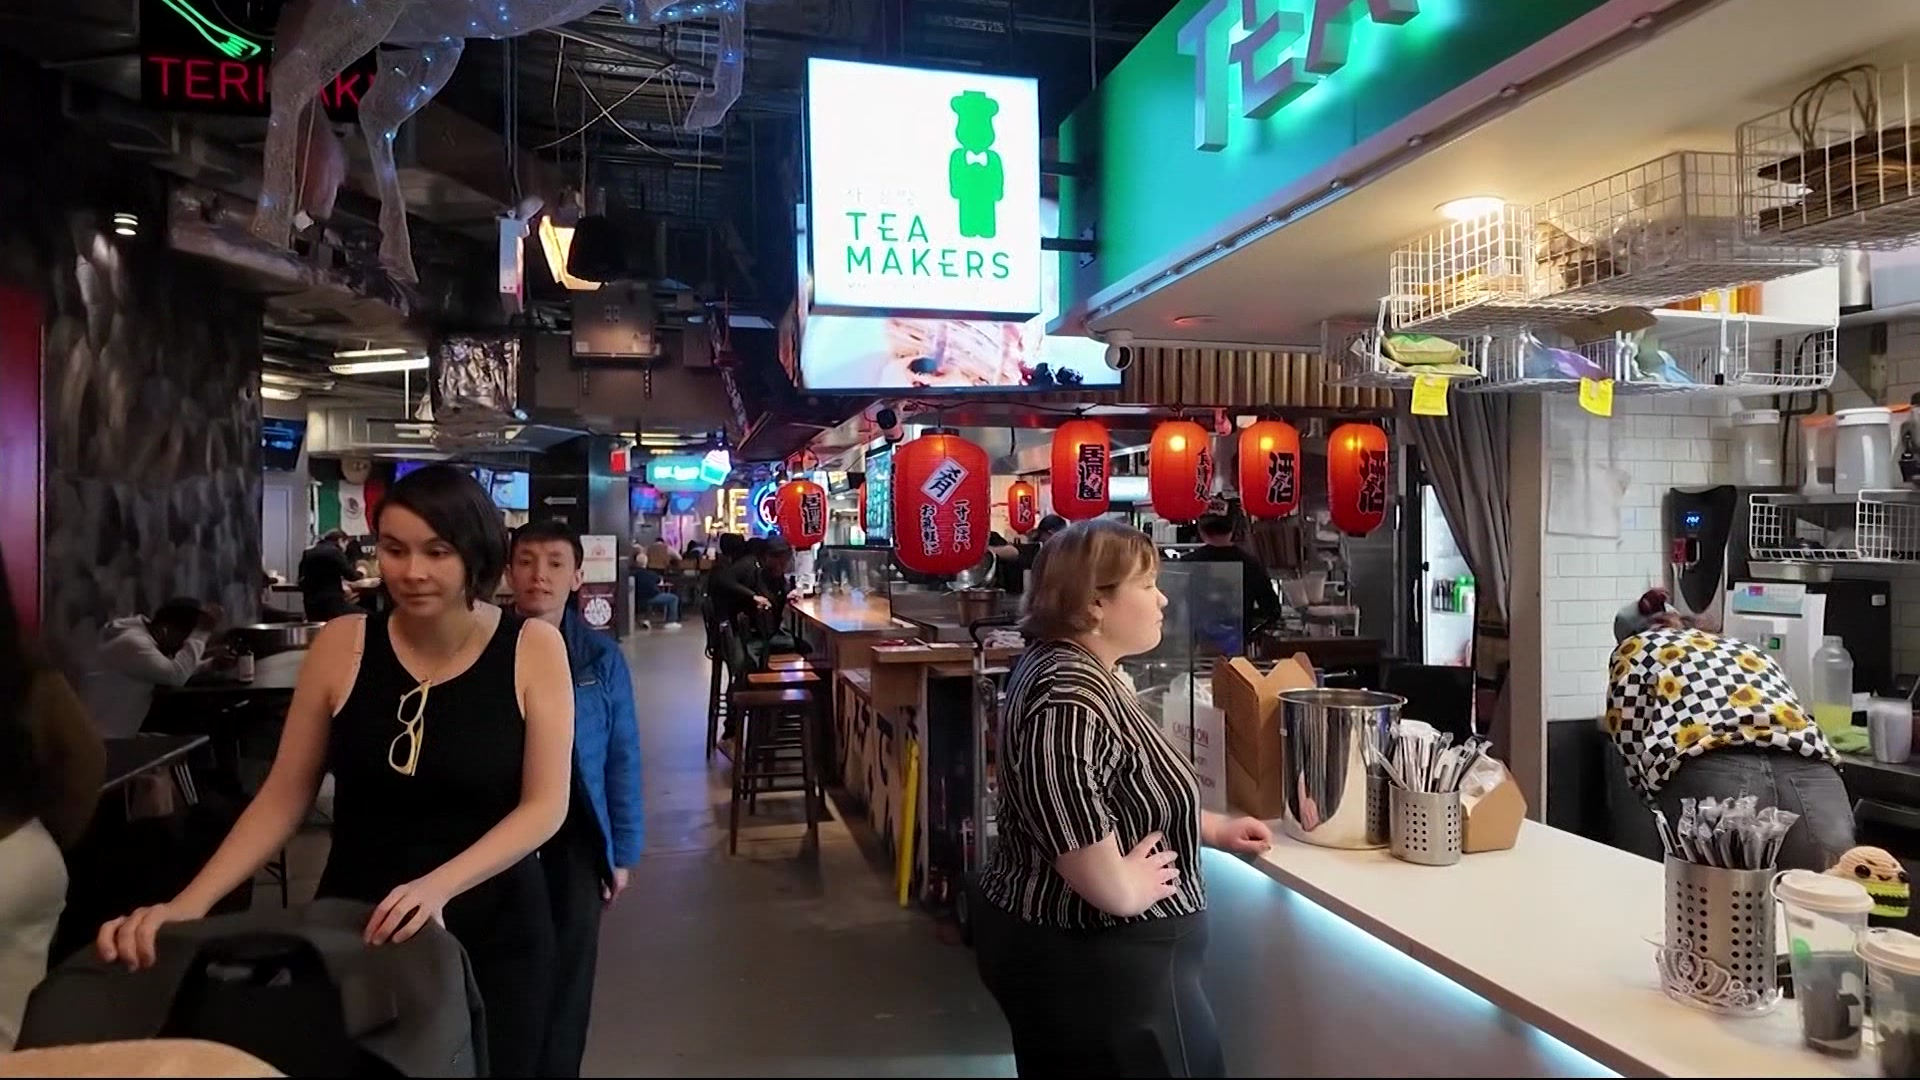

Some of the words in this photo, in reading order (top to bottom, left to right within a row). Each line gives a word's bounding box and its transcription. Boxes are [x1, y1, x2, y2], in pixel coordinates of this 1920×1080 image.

[845, 211, 930, 243] TEA
[846, 245, 1010, 279] MAKERS
[1173, 722, 1209, 746] CAUTON
